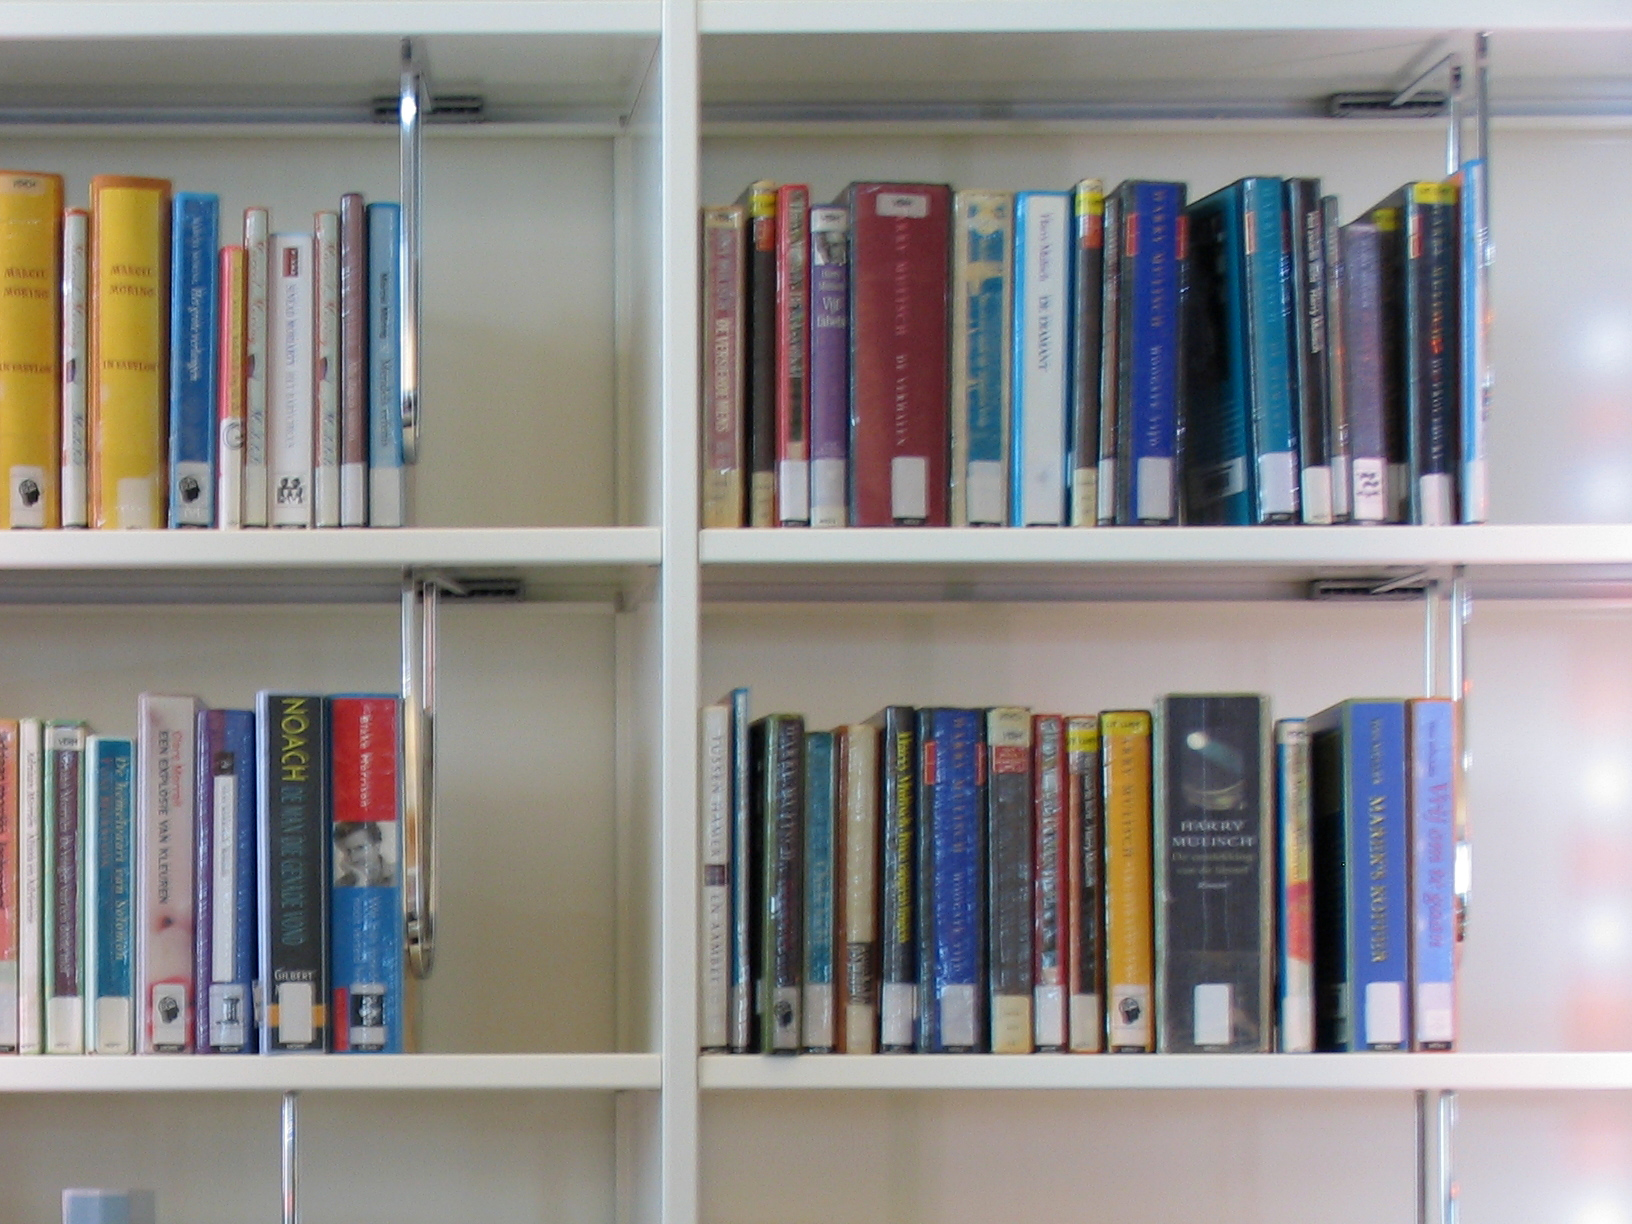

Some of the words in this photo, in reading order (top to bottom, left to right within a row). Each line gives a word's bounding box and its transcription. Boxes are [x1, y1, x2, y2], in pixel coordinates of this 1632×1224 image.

[157, 731, 170, 755] EEN
[281, 698, 311, 782] NOACH
[114, 757, 131, 777] De
[157, 760, 171, 816] EXPLOSIE
[359, 753, 373, 808] Morrison
[280, 786, 306, 802] DE
[157, 821, 170, 843] VAN
[1180, 820, 1245, 832] HARRY
[115, 868, 128, 894] van
[157, 849, 170, 905] KLEUREN
